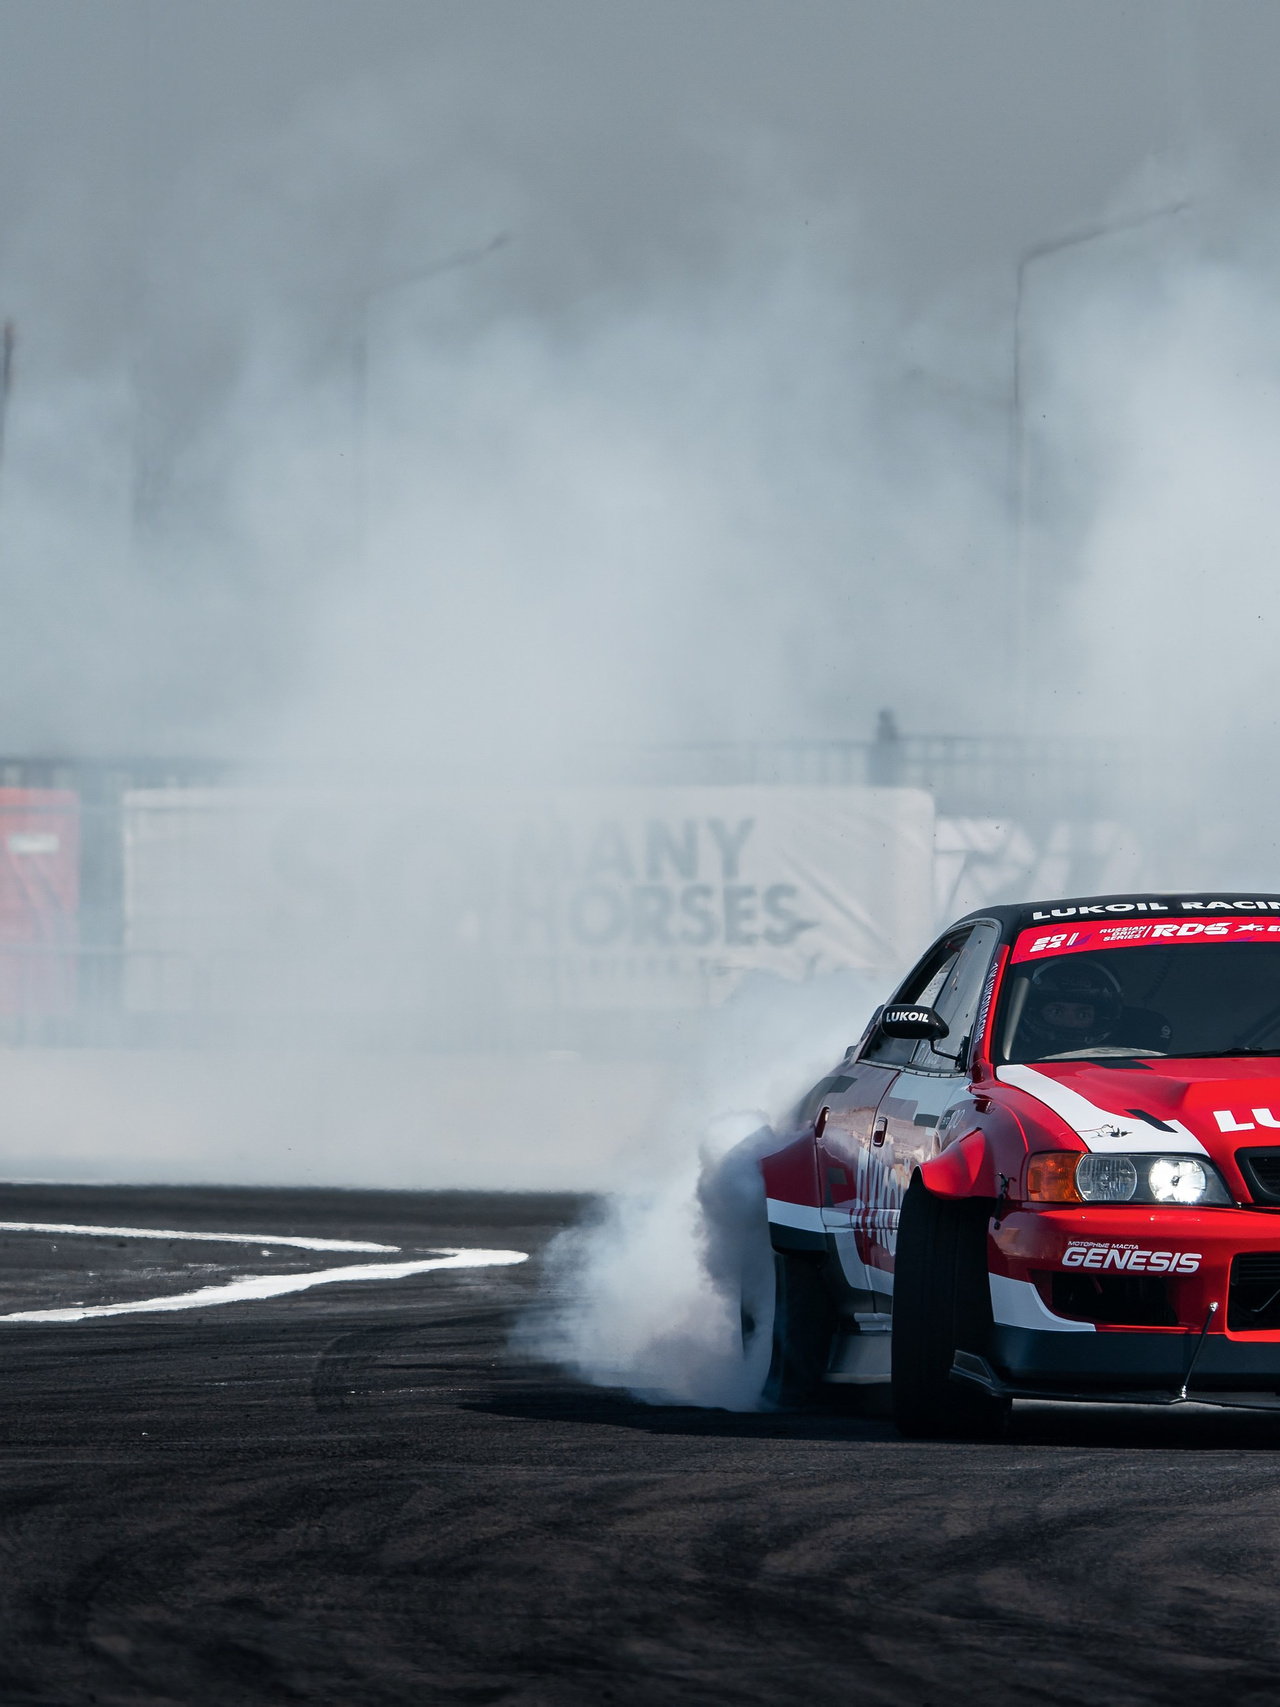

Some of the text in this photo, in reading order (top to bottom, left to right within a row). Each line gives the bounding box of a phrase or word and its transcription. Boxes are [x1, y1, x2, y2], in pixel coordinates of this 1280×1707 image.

[513, 816, 756, 879] MANY
[511, 884, 799, 947] HORSES
[1033, 902, 1169, 920] LUKOIL
[1099, 925, 1147, 934] RUSSIAN
[885, 1011, 929, 1023] LUKOIL
[1061, 1246, 1202, 1273] GENESIS
